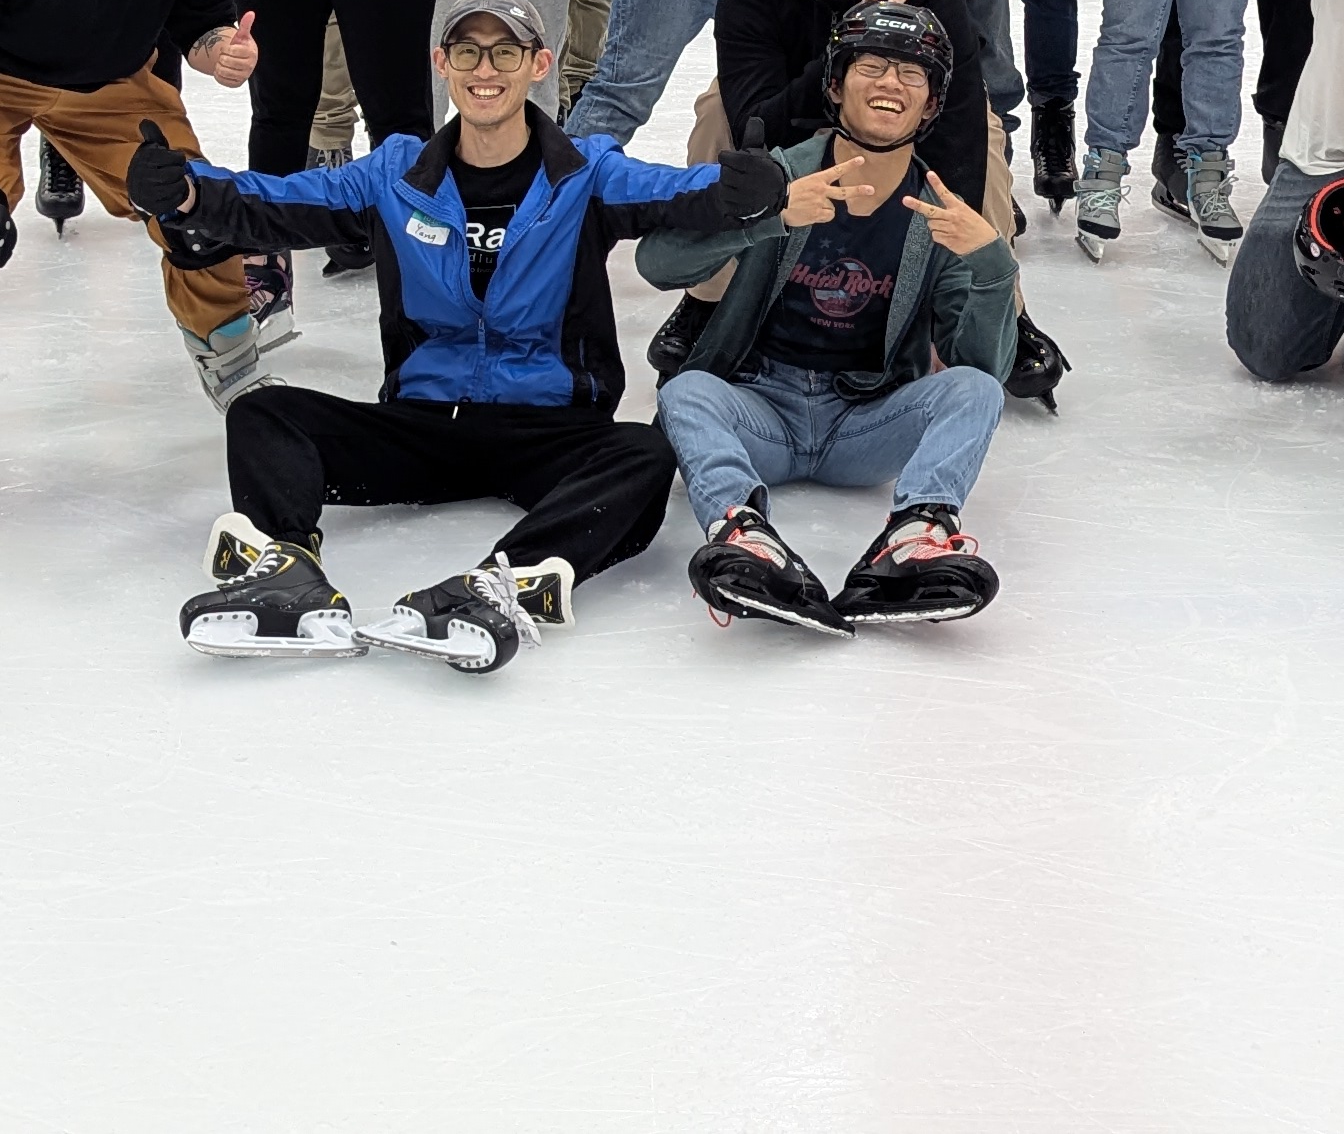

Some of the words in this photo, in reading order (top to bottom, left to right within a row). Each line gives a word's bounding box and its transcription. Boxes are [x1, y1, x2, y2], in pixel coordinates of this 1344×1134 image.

[875, 18, 917, 32] CCM
[414, 222, 437, 243] Yang
[789, 263, 846, 289] Hard
[844, 270, 894, 299] Rock
